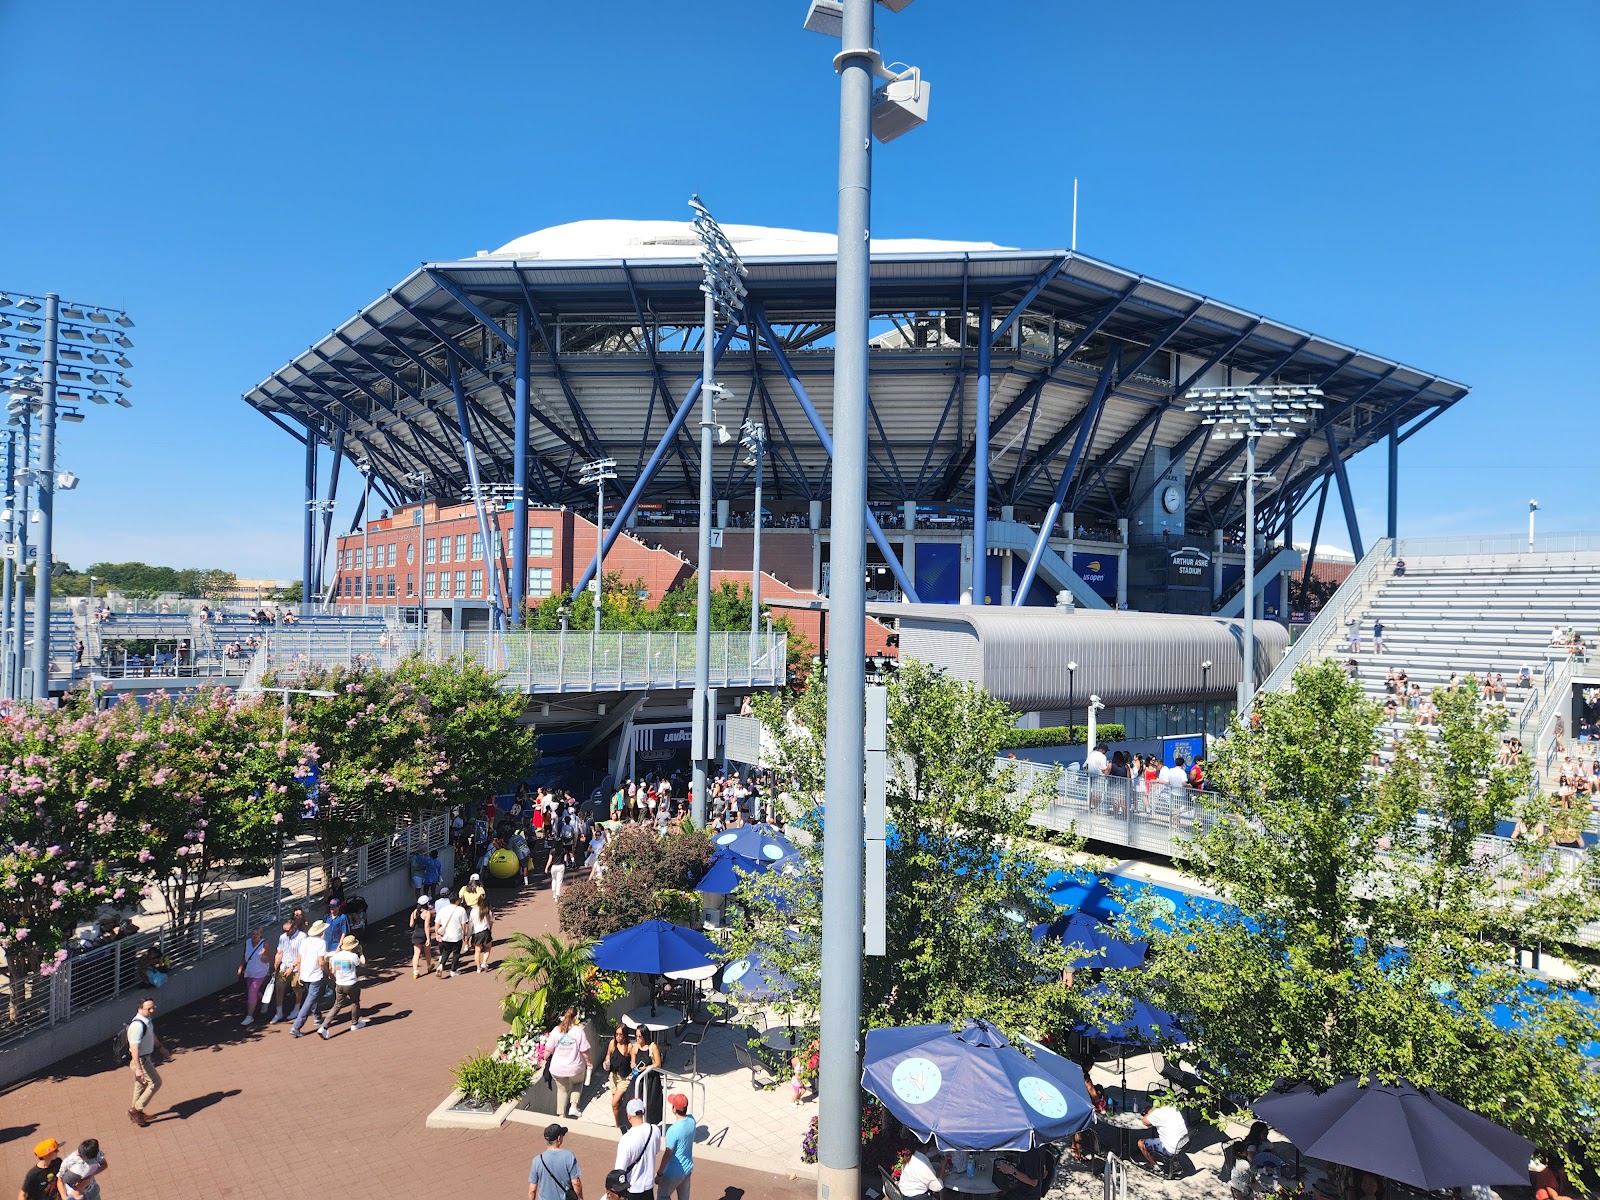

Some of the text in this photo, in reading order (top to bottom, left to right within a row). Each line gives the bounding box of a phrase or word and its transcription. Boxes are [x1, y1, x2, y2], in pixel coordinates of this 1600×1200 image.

[713, 532, 720, 545] 7
[6, 546, 15, 556] 5
[29, 547, 37, 557] 6
[1172, 557, 1209, 568] ARTHUR ASHE
[1178, 566, 1202, 576] STADIUM
[1090, 574, 1104, 583] open
[866, 675, 896, 684] TEQUA
[663, 729, 692, 742] LAVAZ
